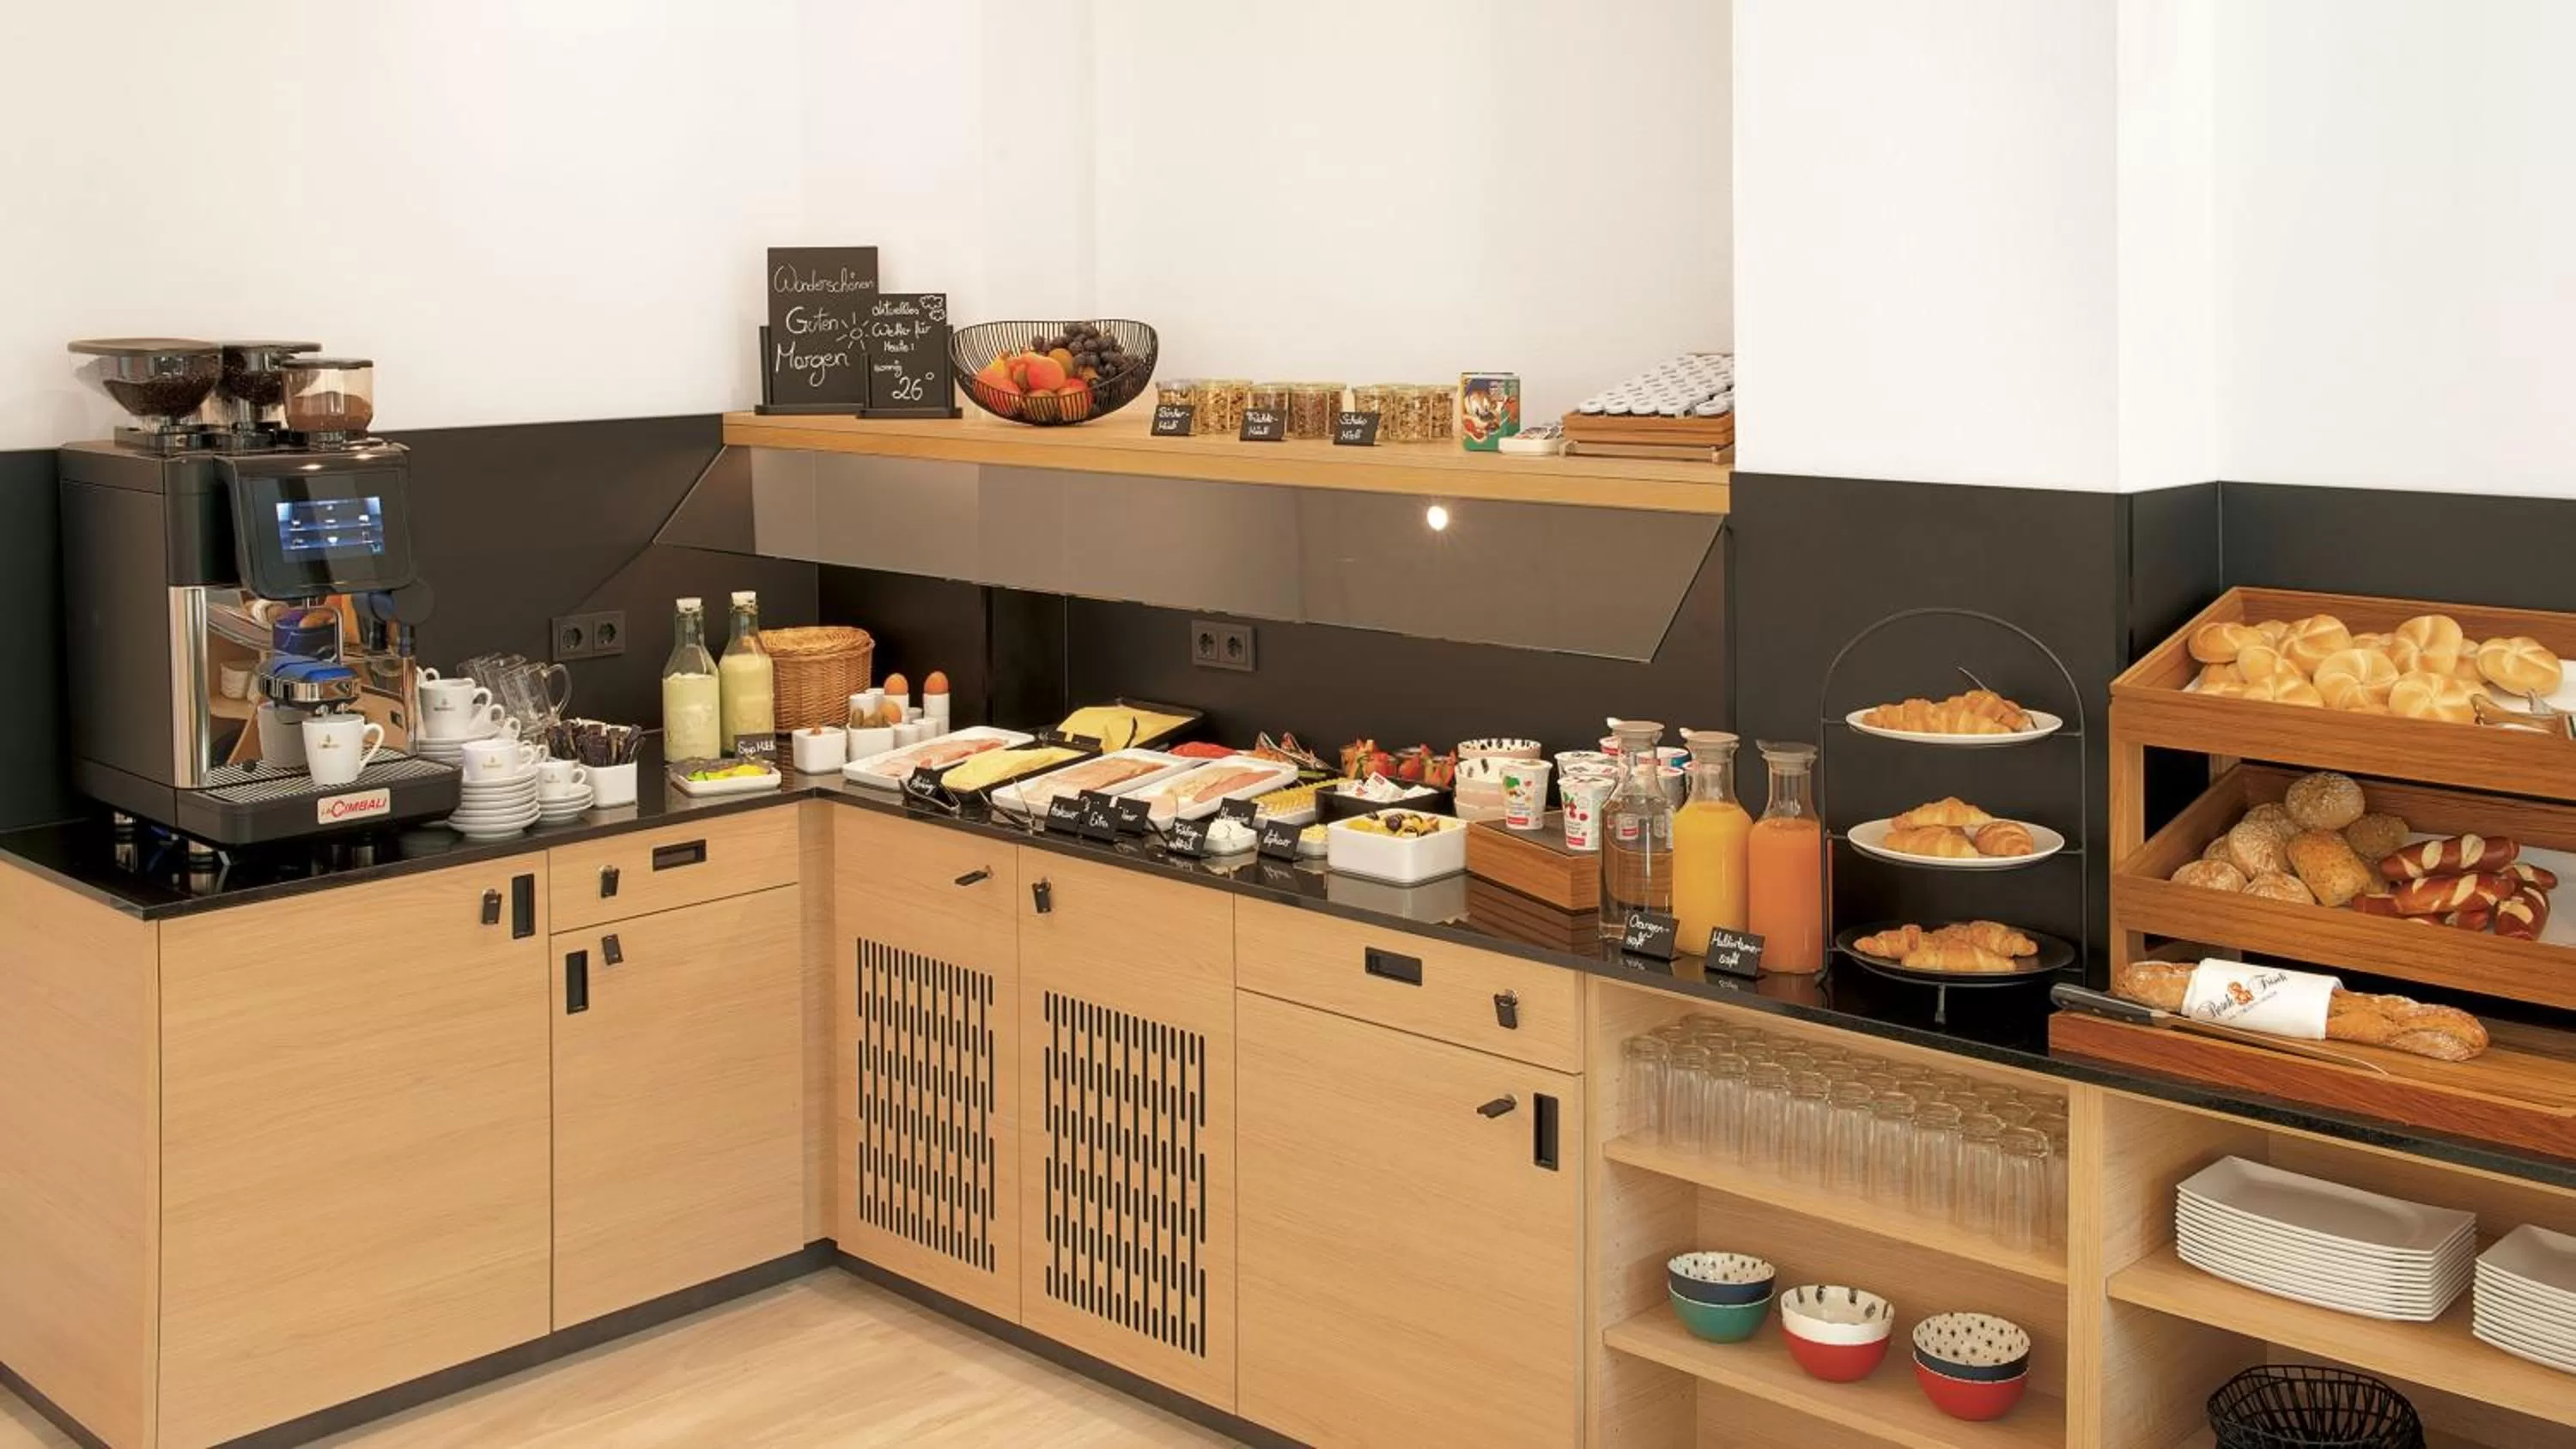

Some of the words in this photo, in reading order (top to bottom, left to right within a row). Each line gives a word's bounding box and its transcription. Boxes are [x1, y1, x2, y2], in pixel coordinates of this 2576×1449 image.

[786, 306, 839, 335] Guten
[914, 319, 932, 339] für
[775, 341, 850, 387] Morgen
